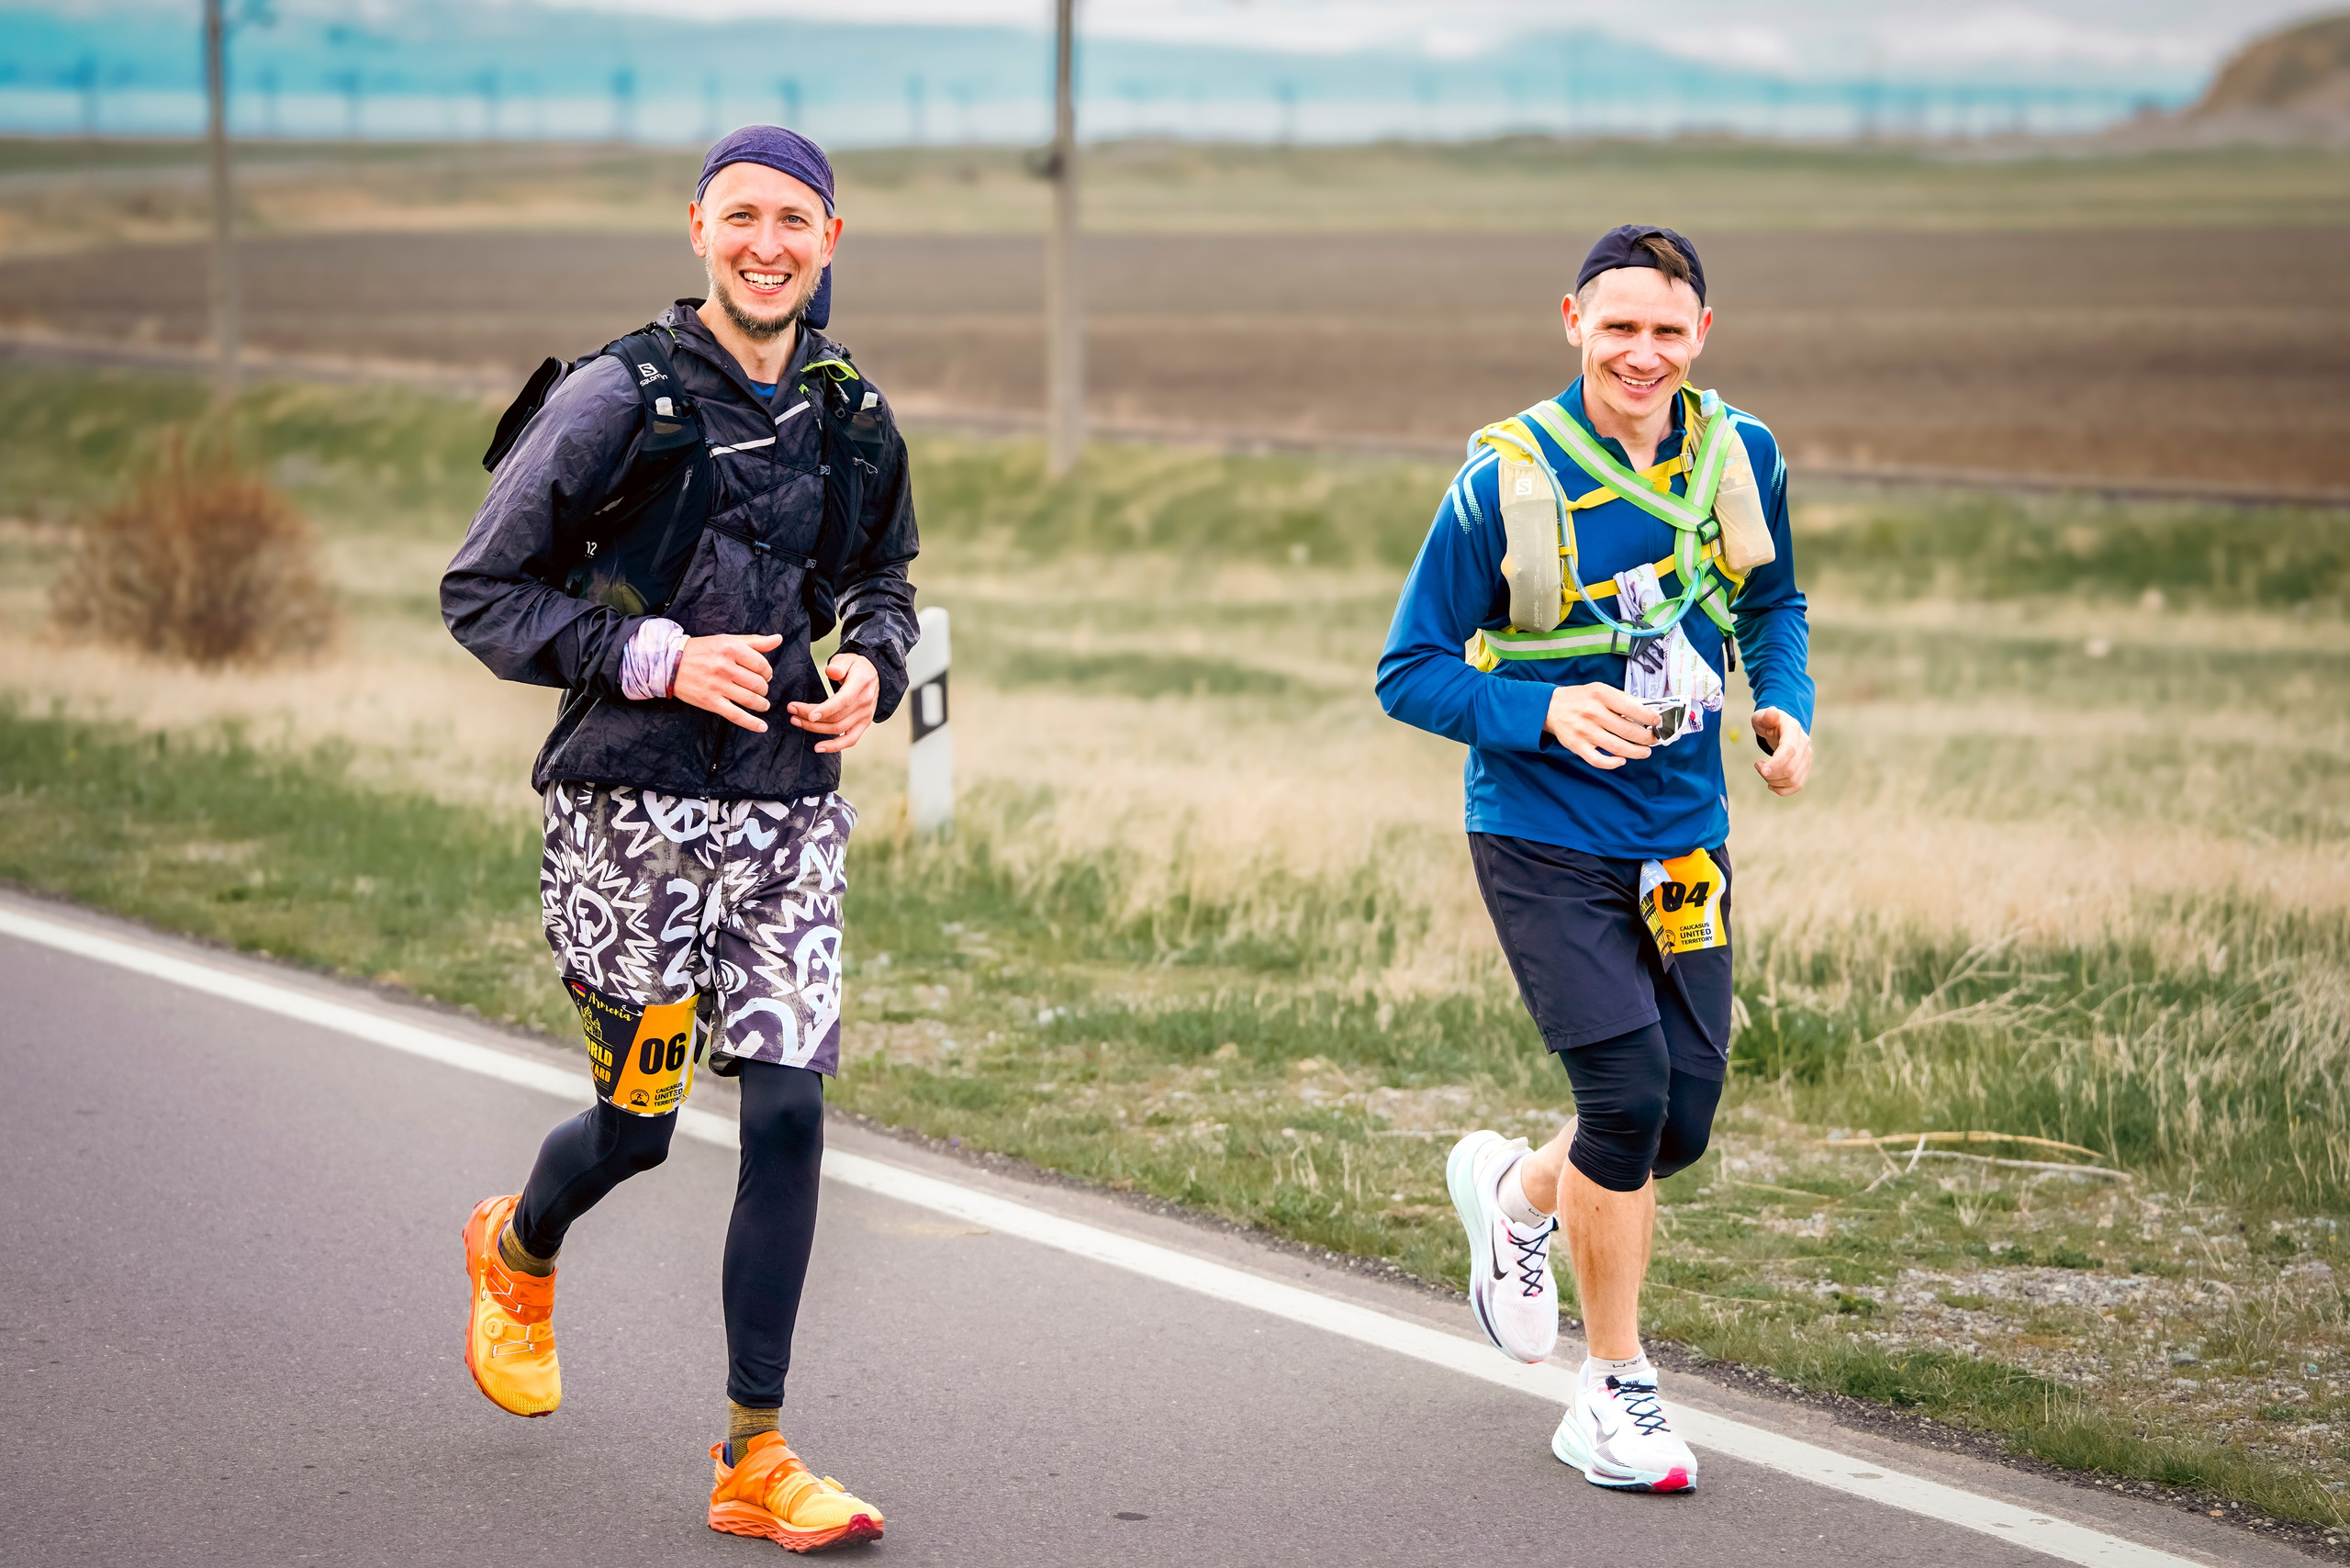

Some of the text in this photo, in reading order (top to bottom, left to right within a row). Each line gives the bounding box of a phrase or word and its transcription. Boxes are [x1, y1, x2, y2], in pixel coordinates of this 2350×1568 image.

[639, 374, 668, 386] salomn
[586, 541, 598, 555] 12
[1661, 881, 1710, 913] 04
[1680, 923, 1710, 931] CAUCASUS
[1680, 929, 1711, 938] UNITED
[1681, 936, 1712, 945] TERRITORY
[588, 991, 634, 1022] Armenia
[585, 1035, 613, 1068] ORLD
[639, 1032, 687, 1075] 06
[655, 1081, 683, 1093] CAUCASUS
[655, 1088, 683, 1101] UNITED
